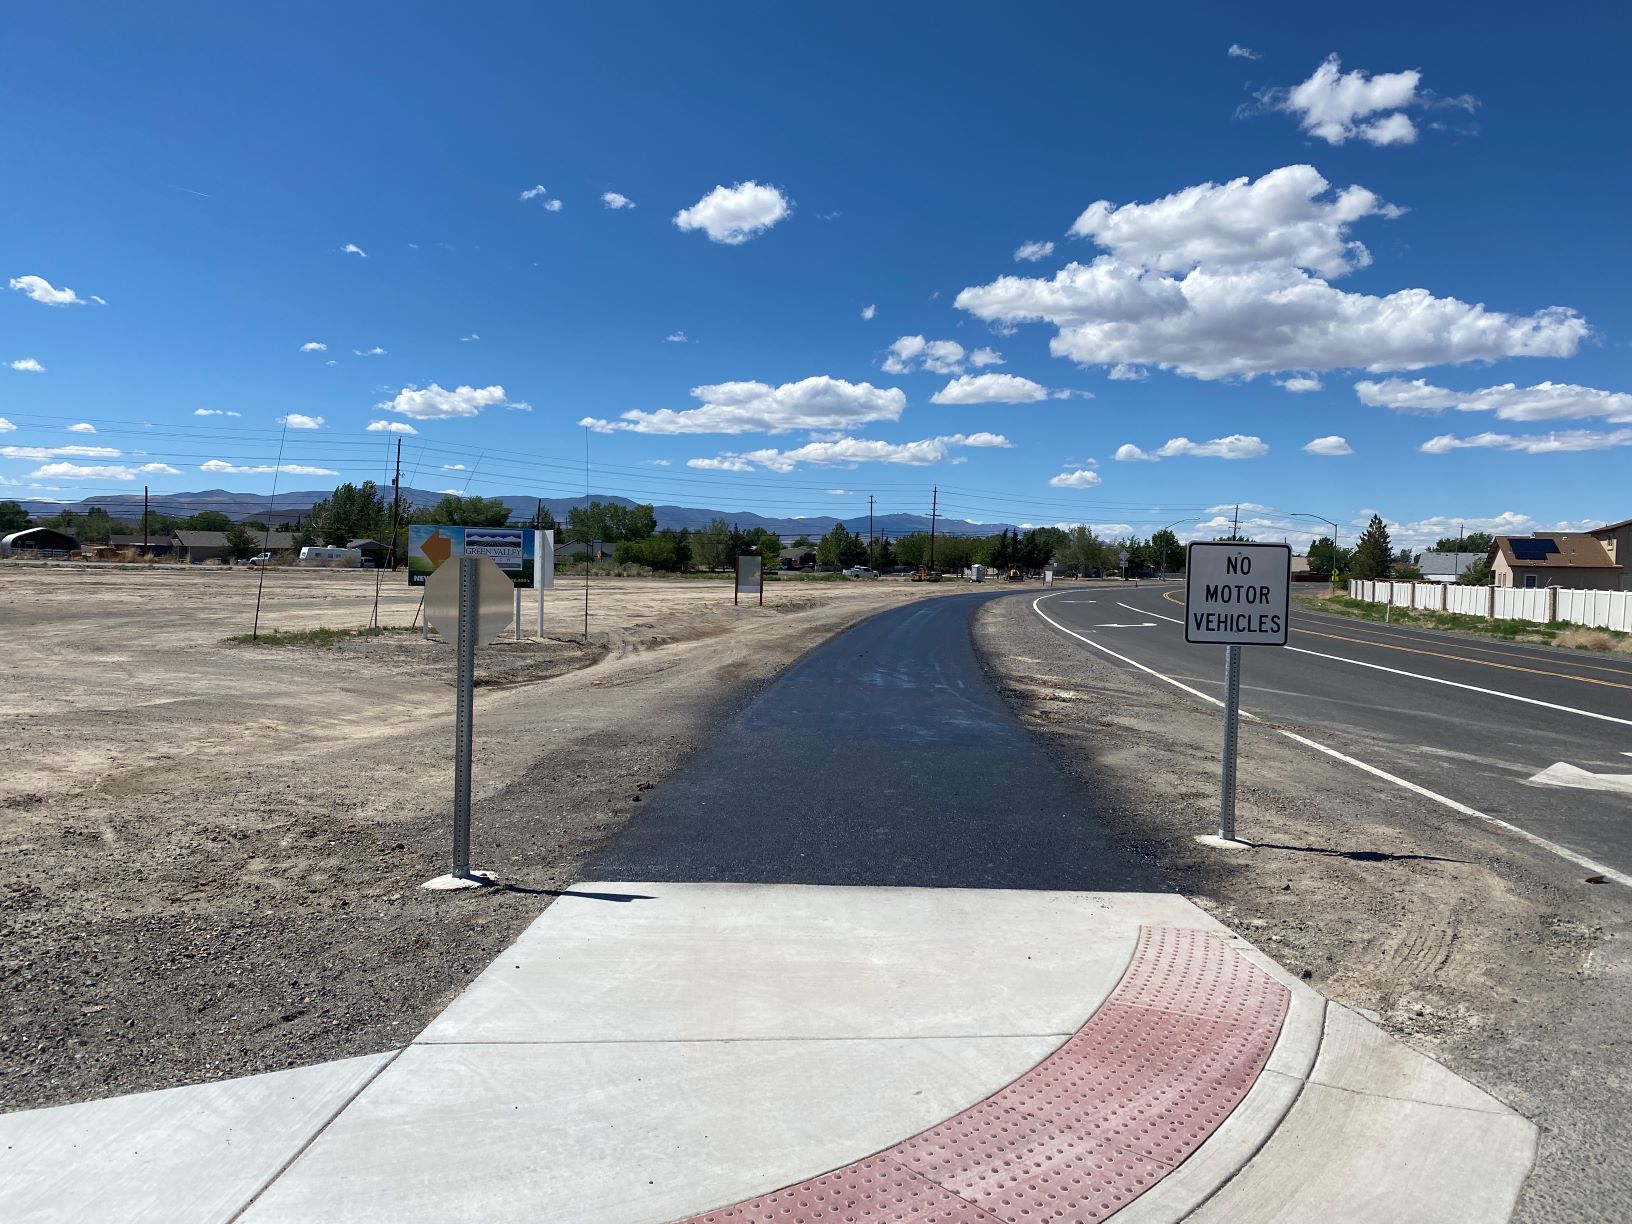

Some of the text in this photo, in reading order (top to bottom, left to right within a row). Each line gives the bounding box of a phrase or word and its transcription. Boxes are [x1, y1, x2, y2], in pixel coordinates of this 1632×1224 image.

[493, 548, 521, 556] VALLEY
[1226, 556, 1251, 575] NO
[1205, 584, 1270, 604] MOTOR
[1193, 612, 1281, 633] VEHICLES
